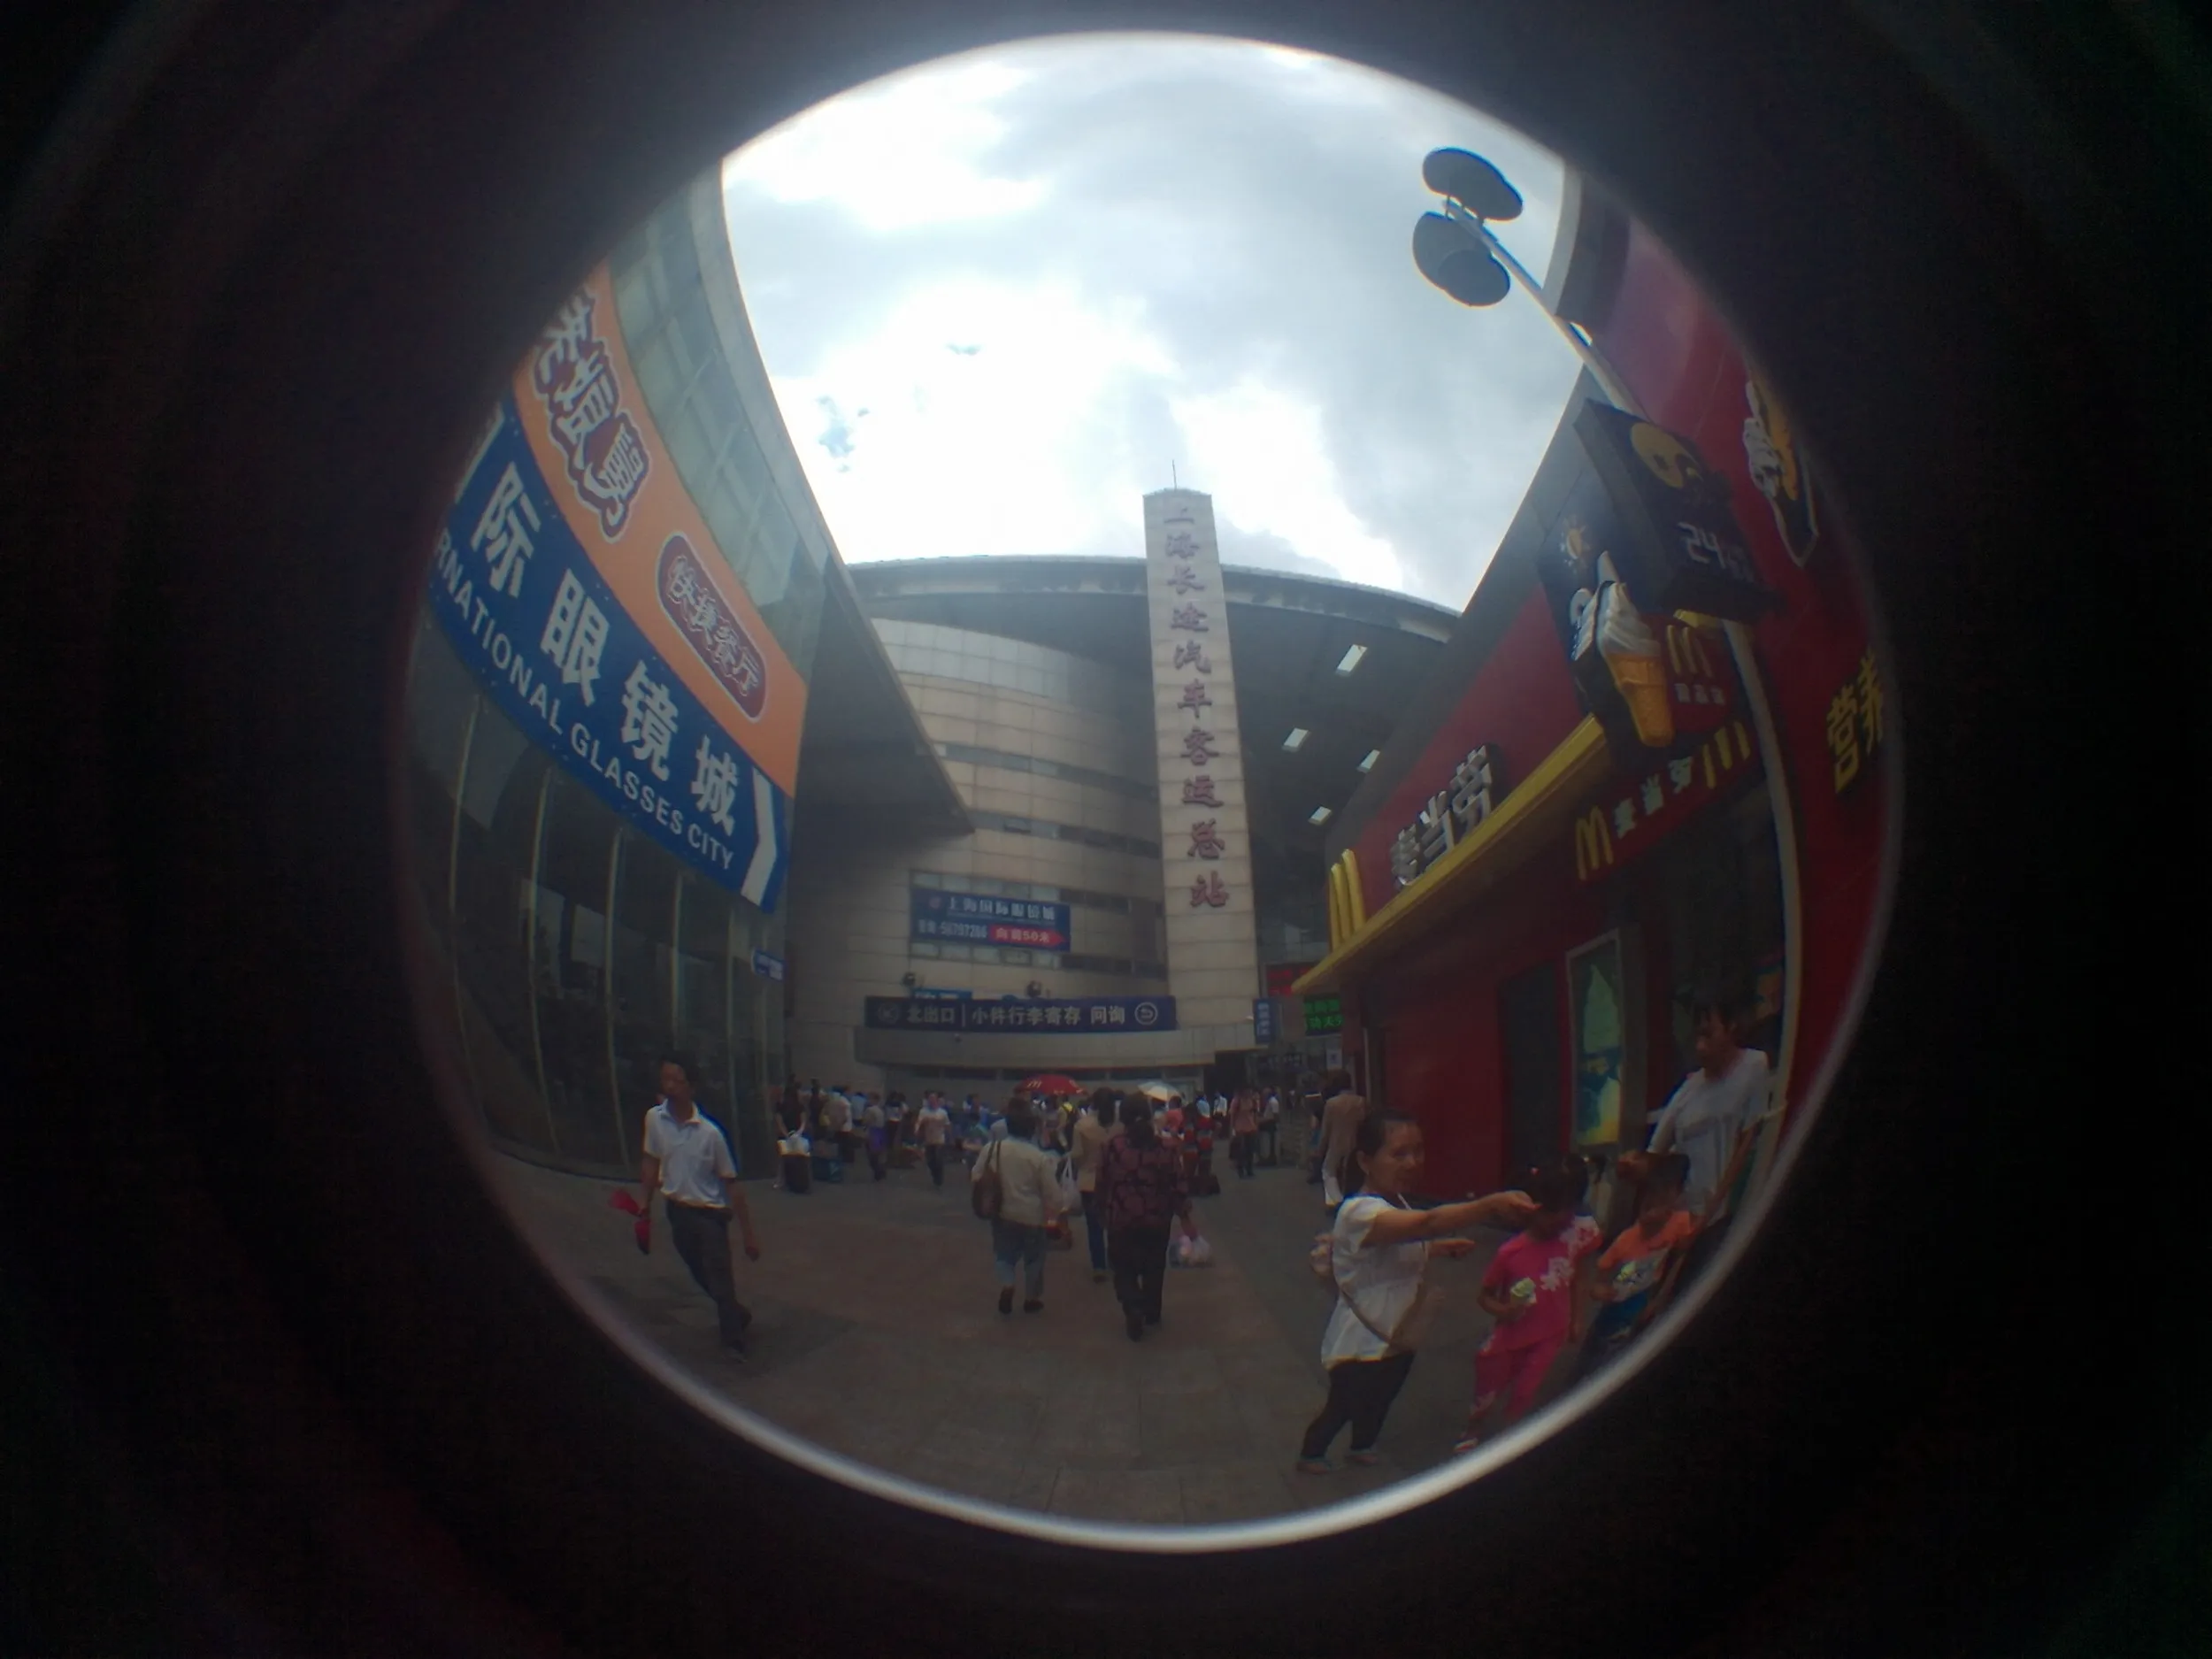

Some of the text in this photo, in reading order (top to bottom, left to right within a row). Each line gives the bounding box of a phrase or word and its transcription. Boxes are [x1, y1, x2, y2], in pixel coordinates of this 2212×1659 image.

[455, 403, 740, 837] 际眼镜城
[1164, 507, 1230, 909] 上海长途汽车客运总站
[571, 726, 683, 835] GLASSES
[687, 824, 735, 870] CITY
[1613, 755, 1694, 840] 麦当劳
[906, 1004, 1126, 1026] 北出口 小件行李寄存 问询
